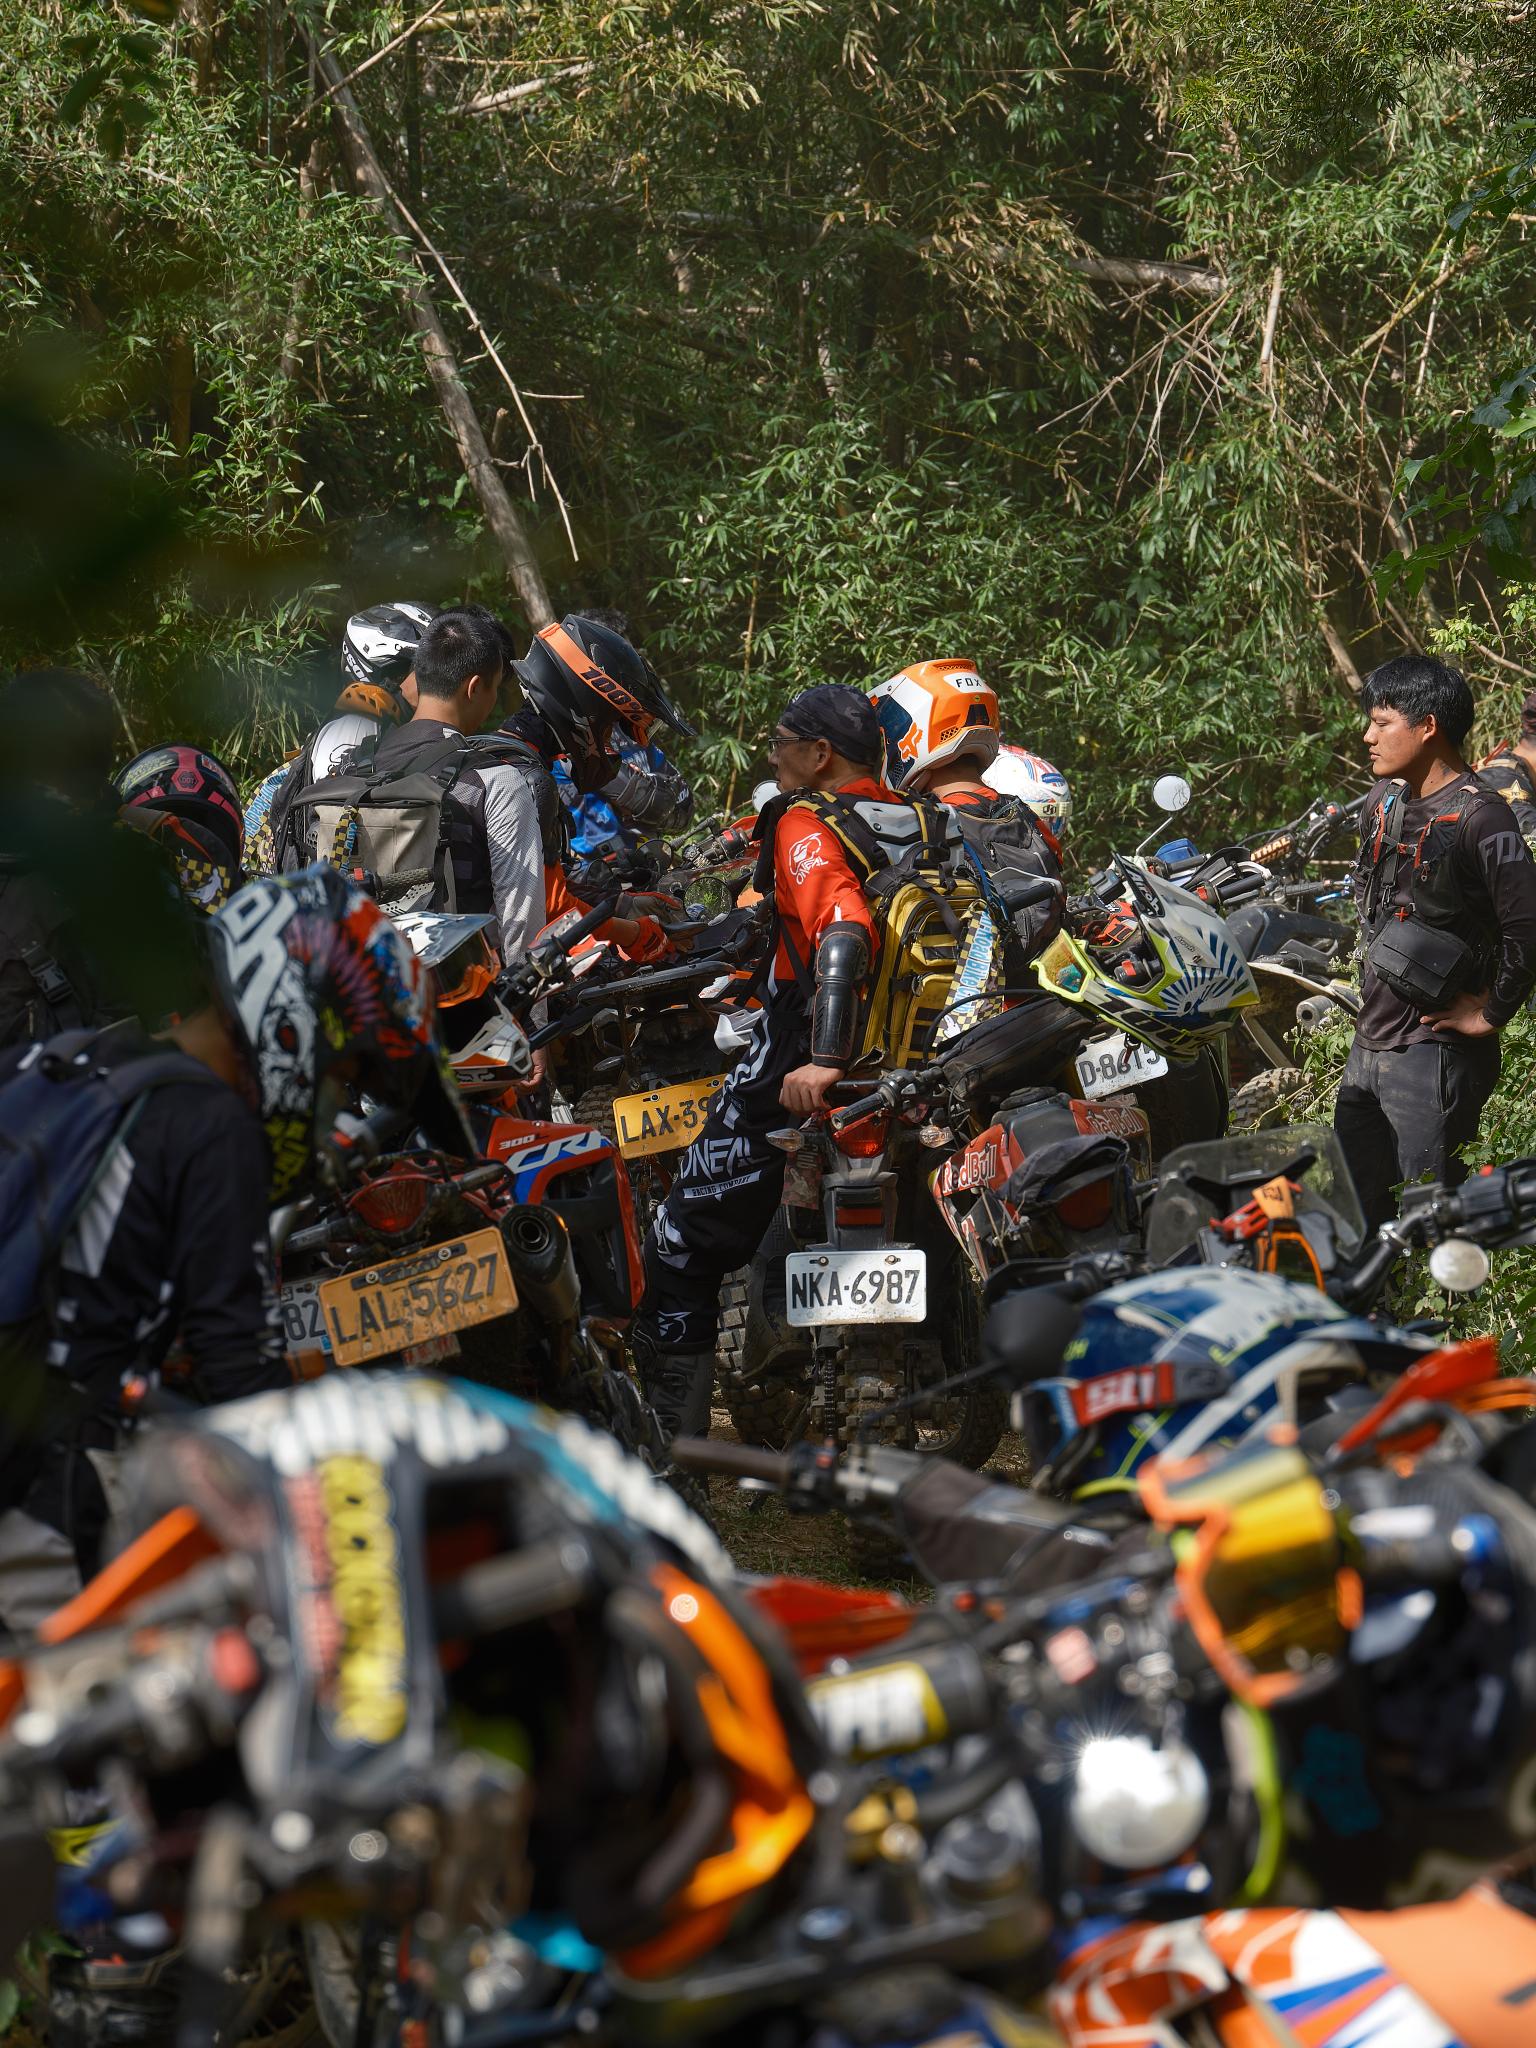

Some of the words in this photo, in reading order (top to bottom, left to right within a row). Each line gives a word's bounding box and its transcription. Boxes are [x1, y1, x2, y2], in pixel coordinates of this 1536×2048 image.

[580, 666, 643, 721] 100%
[955, 677, 982, 688] FOX
[1125, 862, 1161, 912] Airoh
[952, 985, 981, 1013] Clb
[331, 1252, 498, 1345] LAL-5627
[791, 1269, 921, 1310] NKA-6987
